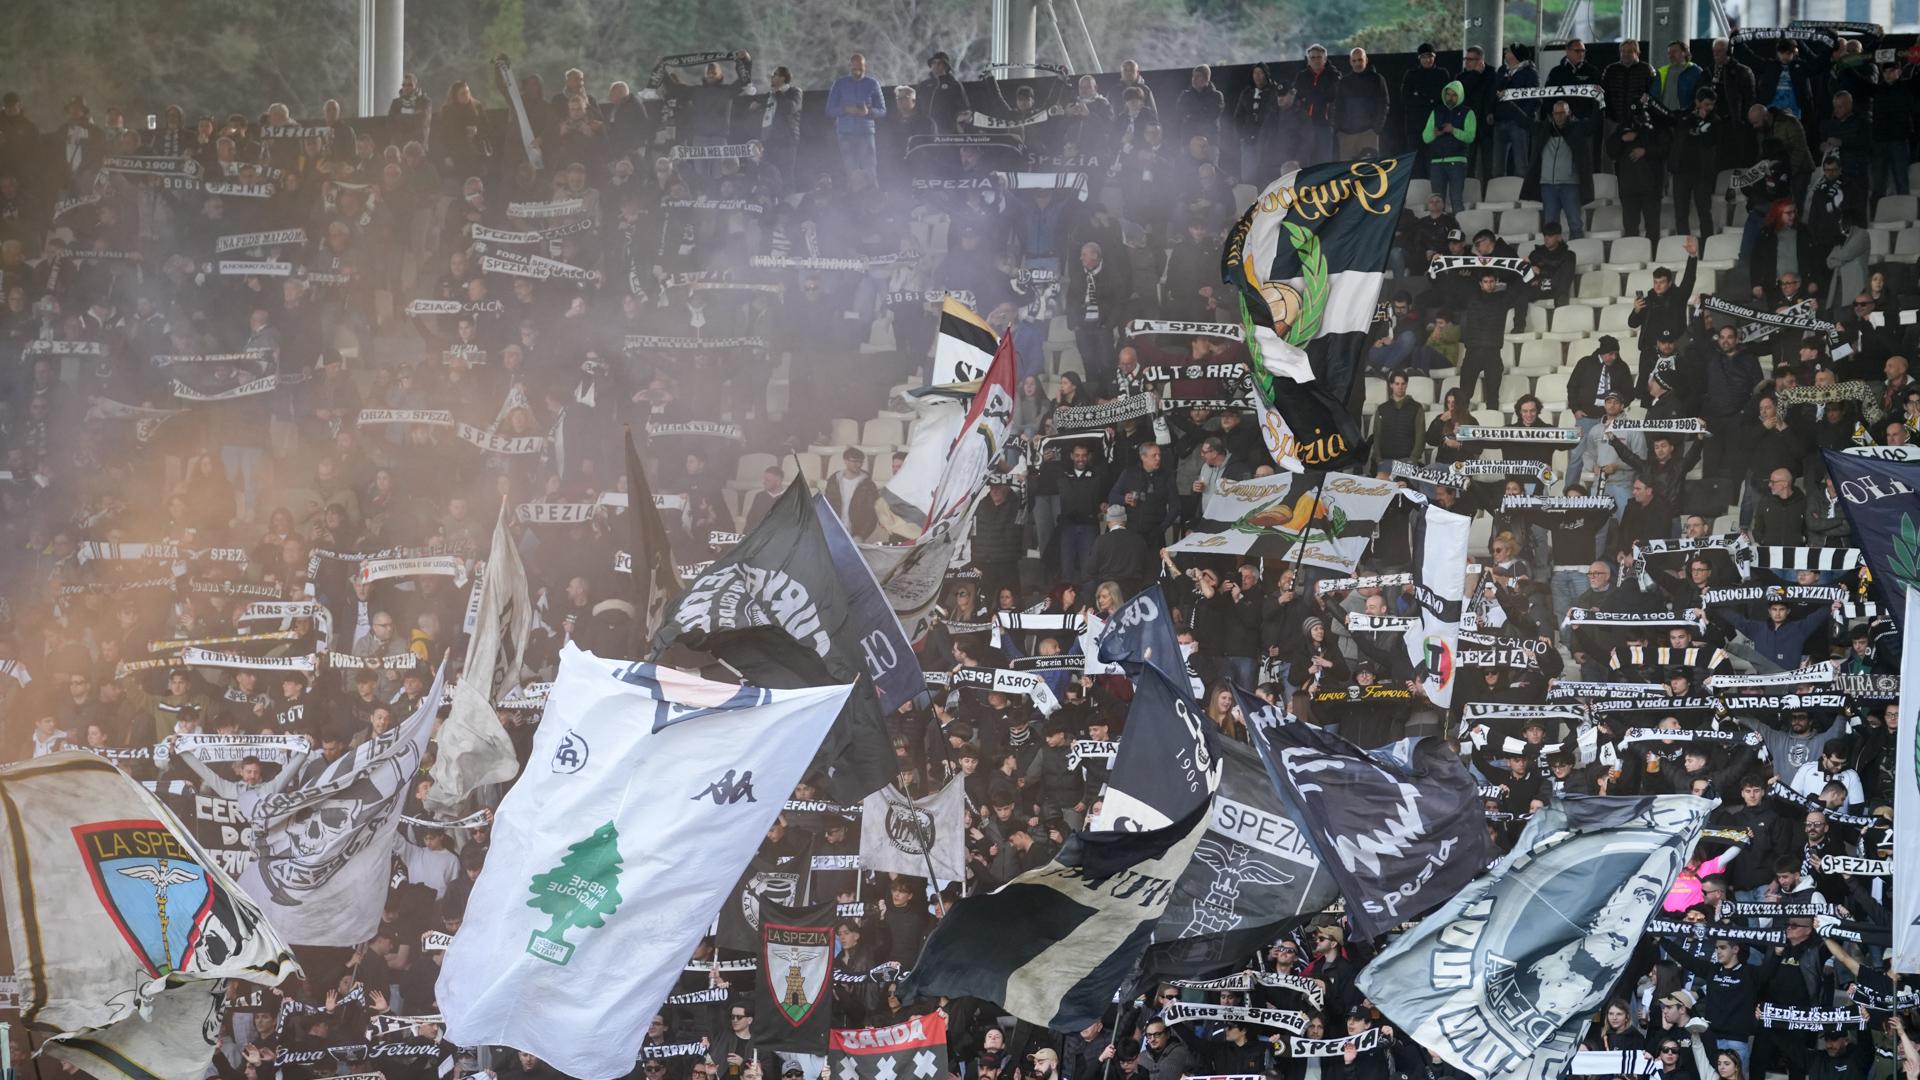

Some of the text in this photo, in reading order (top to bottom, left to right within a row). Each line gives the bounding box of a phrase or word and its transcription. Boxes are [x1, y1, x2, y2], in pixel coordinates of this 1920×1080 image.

[1028, 153, 1098, 168] SPEZIA
[914, 178, 993, 190] SPEZIA
[496, 249, 528, 262] FORZA
[486, 258, 529, 273] SPEZIA
[1756, 311, 1784, 323] vada
[1169, 322, 1240, 338] SPEZIA
[1612, 418, 1698, 431] SPEZIA CALCIO 1906
[463, 426, 542, 453] SPEZIA
[1261, 410, 1348, 465] Spezia
[1481, 466, 1507, 475] STORIA
[520, 504, 594, 523] SPEZIA
[378, 562, 398, 573] NOSTRA
[398, 560, 416, 569] STORIA
[1704, 587, 1763, 603] ORGOGLIO
[1463, 616, 1478, 628] 197
[1595, 611, 1675, 620] SPEZIA 1906
[1497, 636, 1547, 654] CALCIO
[200, 651, 293, 666] CURVA FERROVIA
[329, 651, 417, 668] FORZA SPEZIA
[1036, 658, 1062, 667] Spezia
[1770, 673, 1823, 683] CONTINUA
[1470, 703, 1584, 717] ULTRAS
[1636, 697, 1669, 708] vada
[1672, 698, 1681, 707] a
[1684, 697, 1702, 707] La
[1725, 696, 1780, 709] ULTRAS
[1695, 729, 1734, 740] FORZA
[1068, 741, 1118, 766] SPEZIA
[1174, 747, 1201, 794] 1906
[195, 795, 246, 824] CER
[1217, 803, 1317, 859] SPEZIA
[93, 830, 192, 859] LA SPEZ
[1823, 856, 1884, 873] SPEZIA
[1362, 835, 1459, 918] spezia
[1736, 902, 1834, 916] VECCHIA GUARDIA
[768, 929, 828, 945] LA SPEZIA
[1830, 928, 1862, 940] SPEZIA
[1166, 1004, 1305, 1030] Ultras Spezia
[1766, 1006, 1851, 1022] FEDELISSIMI
[841, 1018, 928, 1050] BANDA
[274, 1044, 326, 1066] Curva
